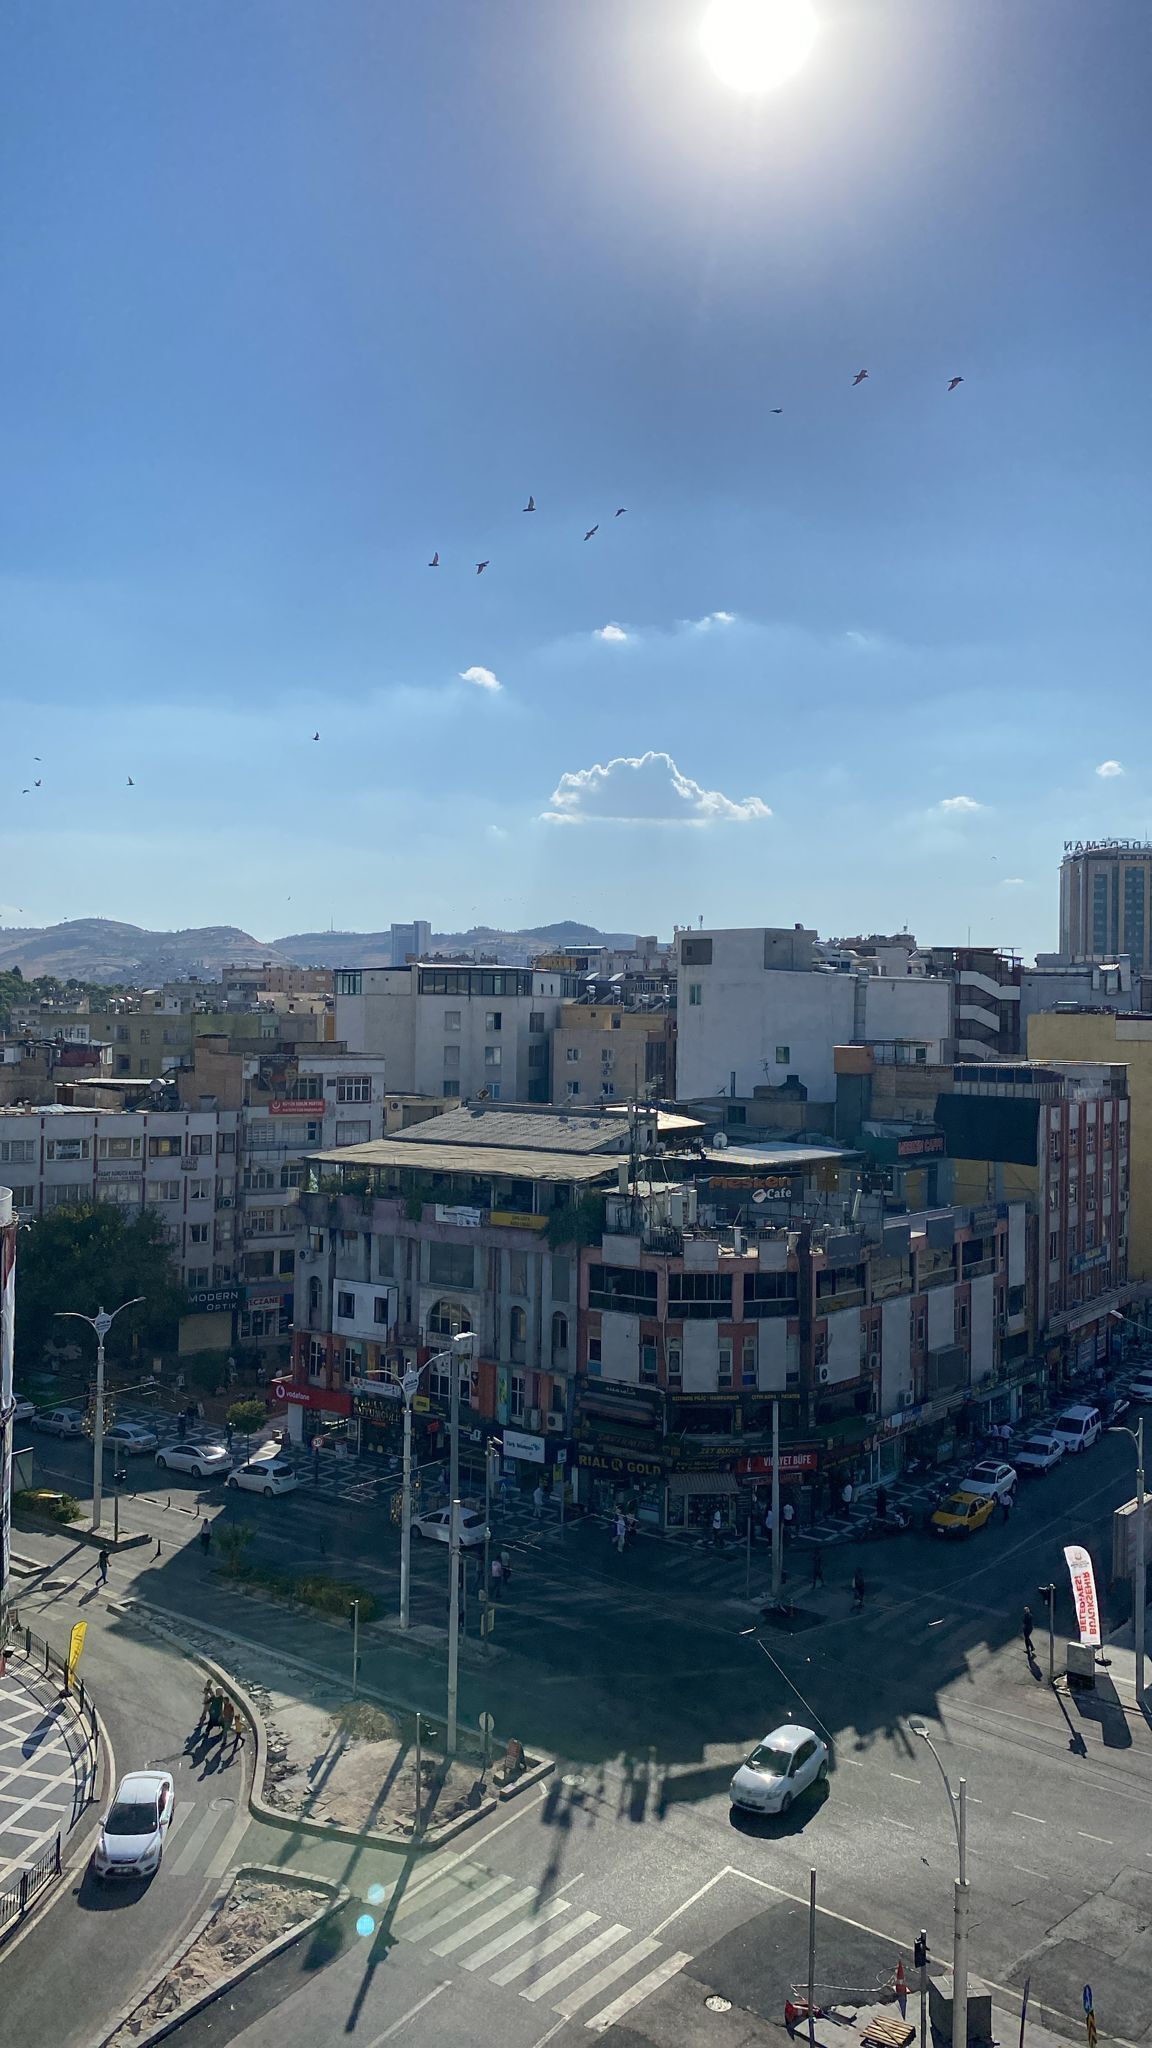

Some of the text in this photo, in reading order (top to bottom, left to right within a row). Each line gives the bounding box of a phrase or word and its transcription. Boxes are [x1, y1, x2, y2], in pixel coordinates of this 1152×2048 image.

[766, 1188, 791, 1200] Cafe
[188, 1292, 239, 1304] MODERN
[285, 1391, 310, 1401] vodafone
[578, 1455, 608, 1469] RIAL
[627, 1462, 661, 1475] GOLD
[793, 1453, 812, 1465] BÜFE
